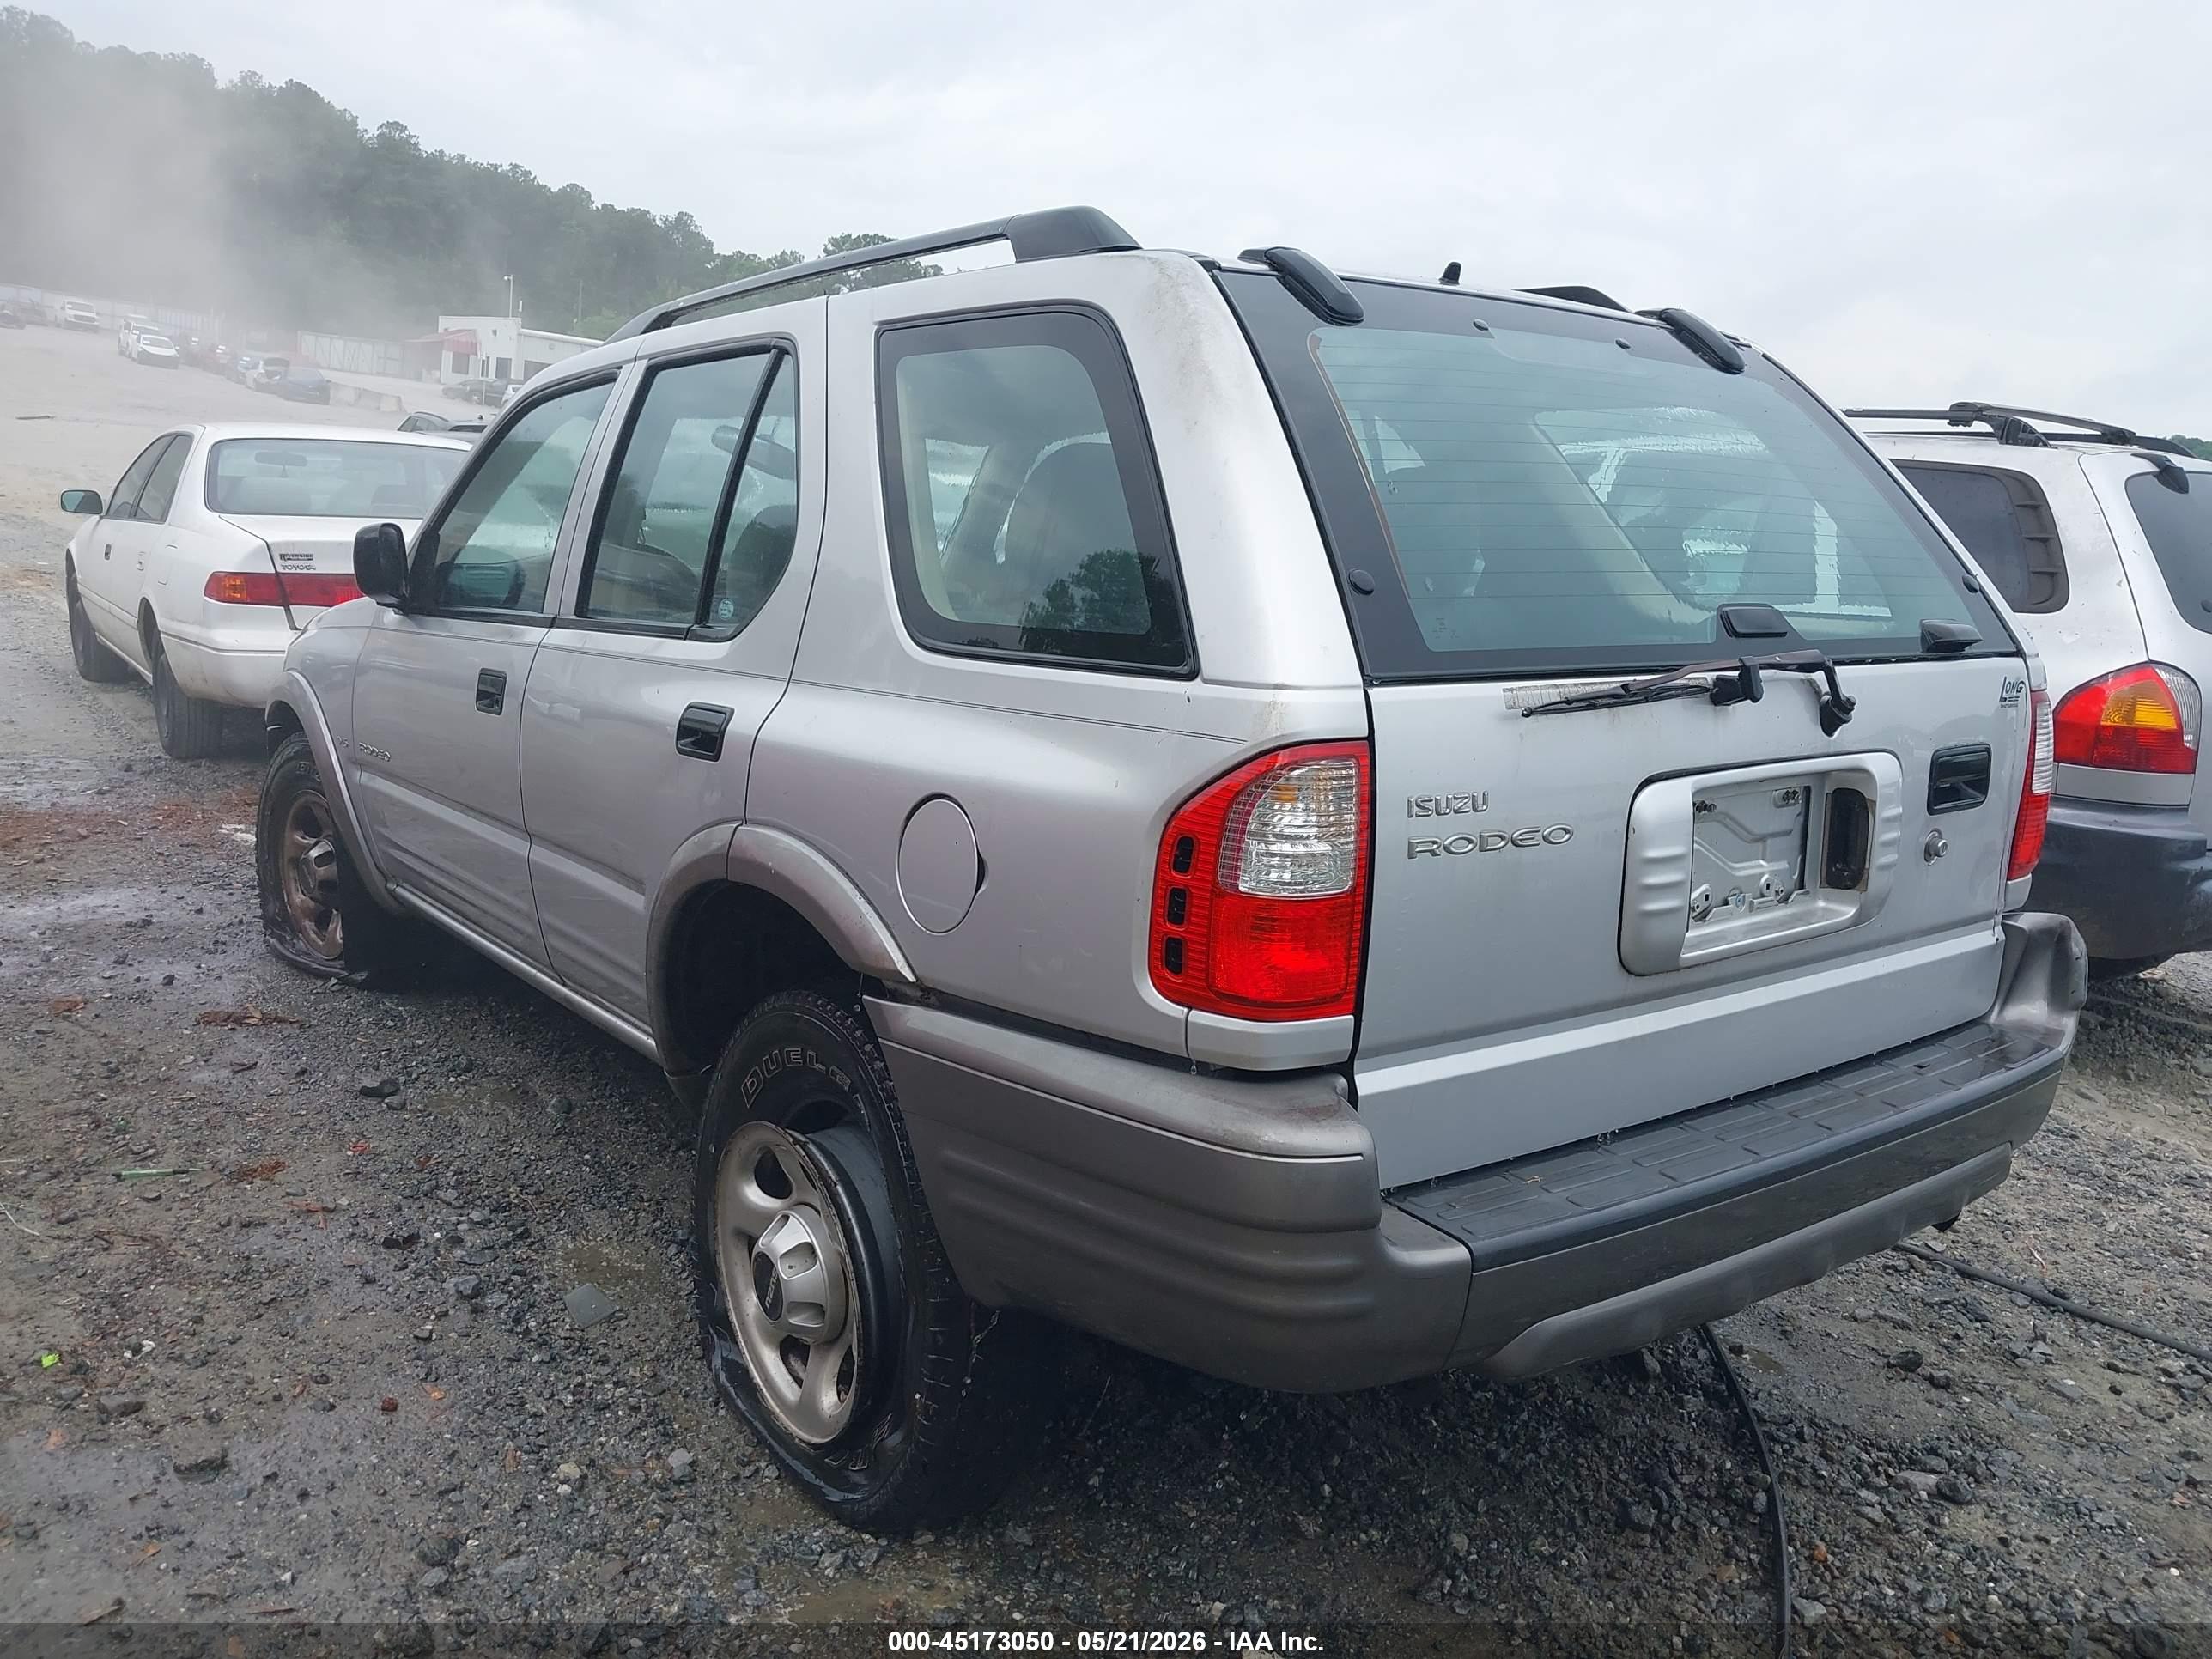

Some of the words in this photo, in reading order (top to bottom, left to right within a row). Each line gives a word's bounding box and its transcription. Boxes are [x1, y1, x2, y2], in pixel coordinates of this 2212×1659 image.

[1998, 676, 2026, 702] LONG
[359, 742, 391, 763] RODEO
[1407, 790, 1489, 818] ISUZU
[1407, 823, 1574, 860] RODEO
